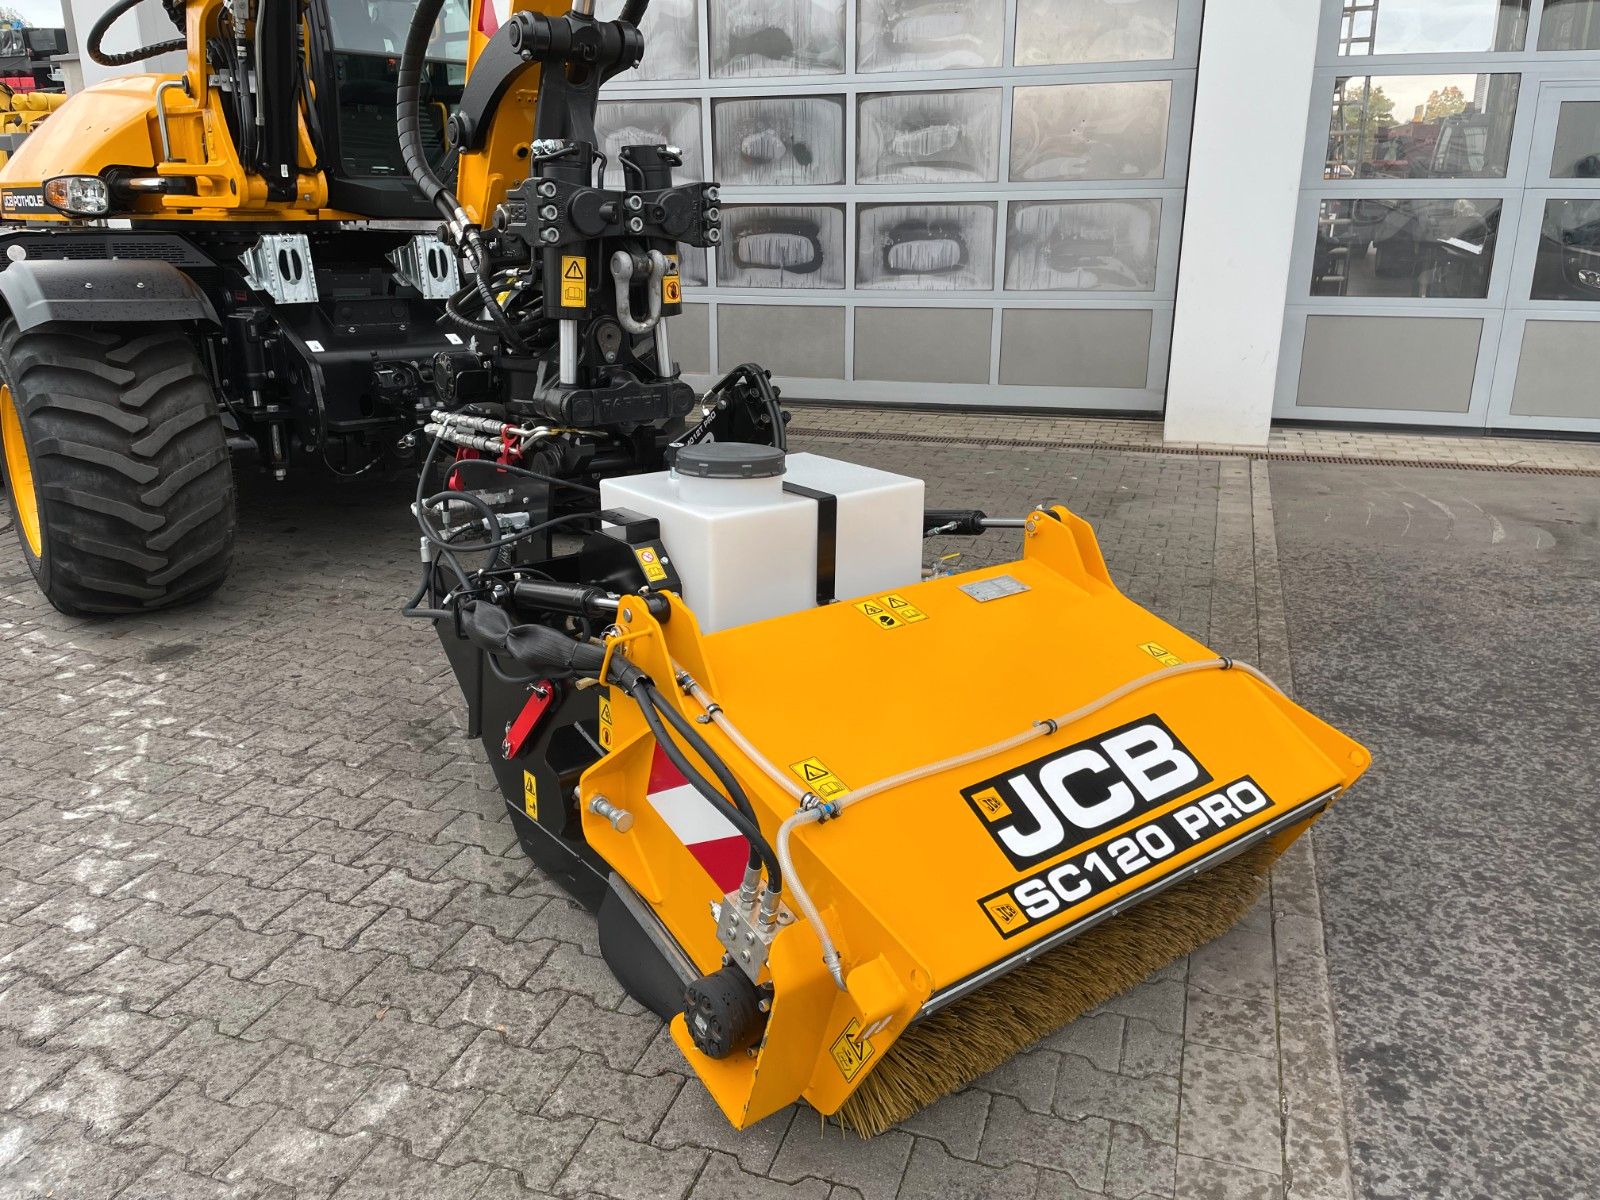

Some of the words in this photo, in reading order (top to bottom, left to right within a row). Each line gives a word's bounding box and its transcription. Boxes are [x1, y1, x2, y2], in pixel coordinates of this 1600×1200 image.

[997, 724, 1199, 857] JCB
[1013, 824, 1176, 919] SC120
[1173, 780, 1267, 841] PRO
[995, 904, 1017, 922] JCB
